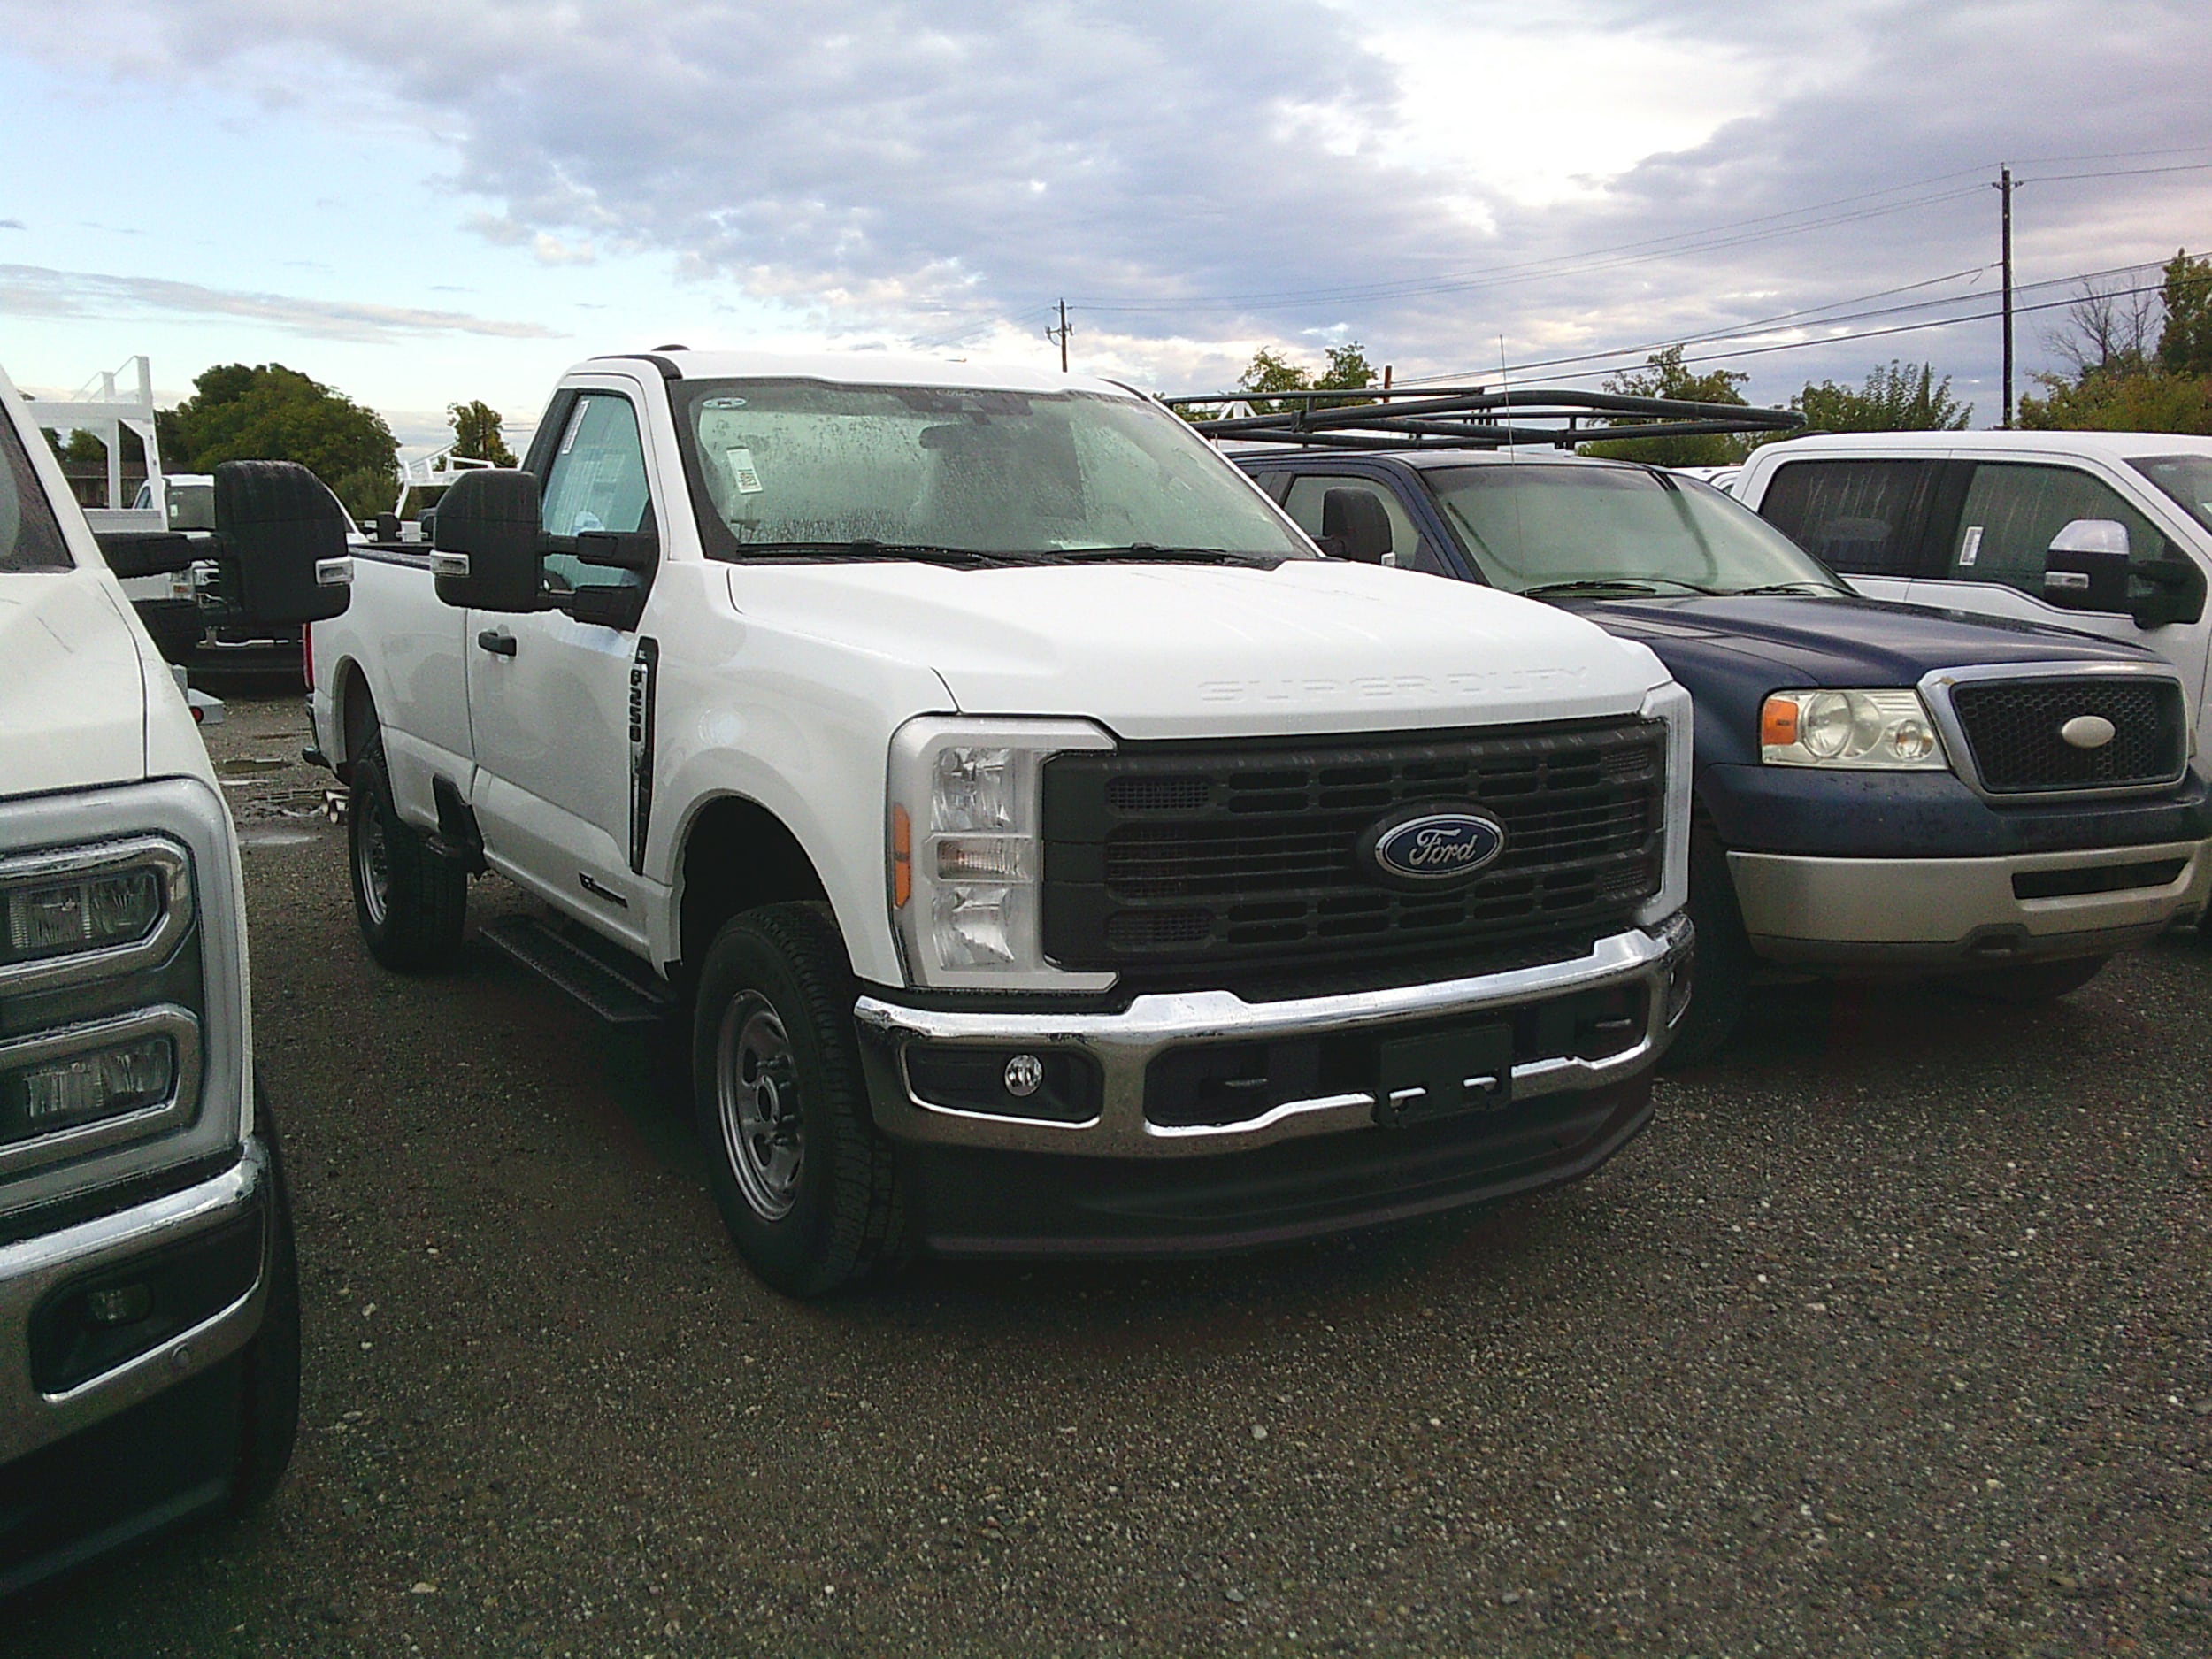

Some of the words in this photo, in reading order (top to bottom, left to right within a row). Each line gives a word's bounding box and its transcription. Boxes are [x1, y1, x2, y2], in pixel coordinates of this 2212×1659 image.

[1197, 674, 1438, 703] SUPER
[1446, 665, 1587, 694] DUTY
[1409, 828, 1478, 865] Ford
